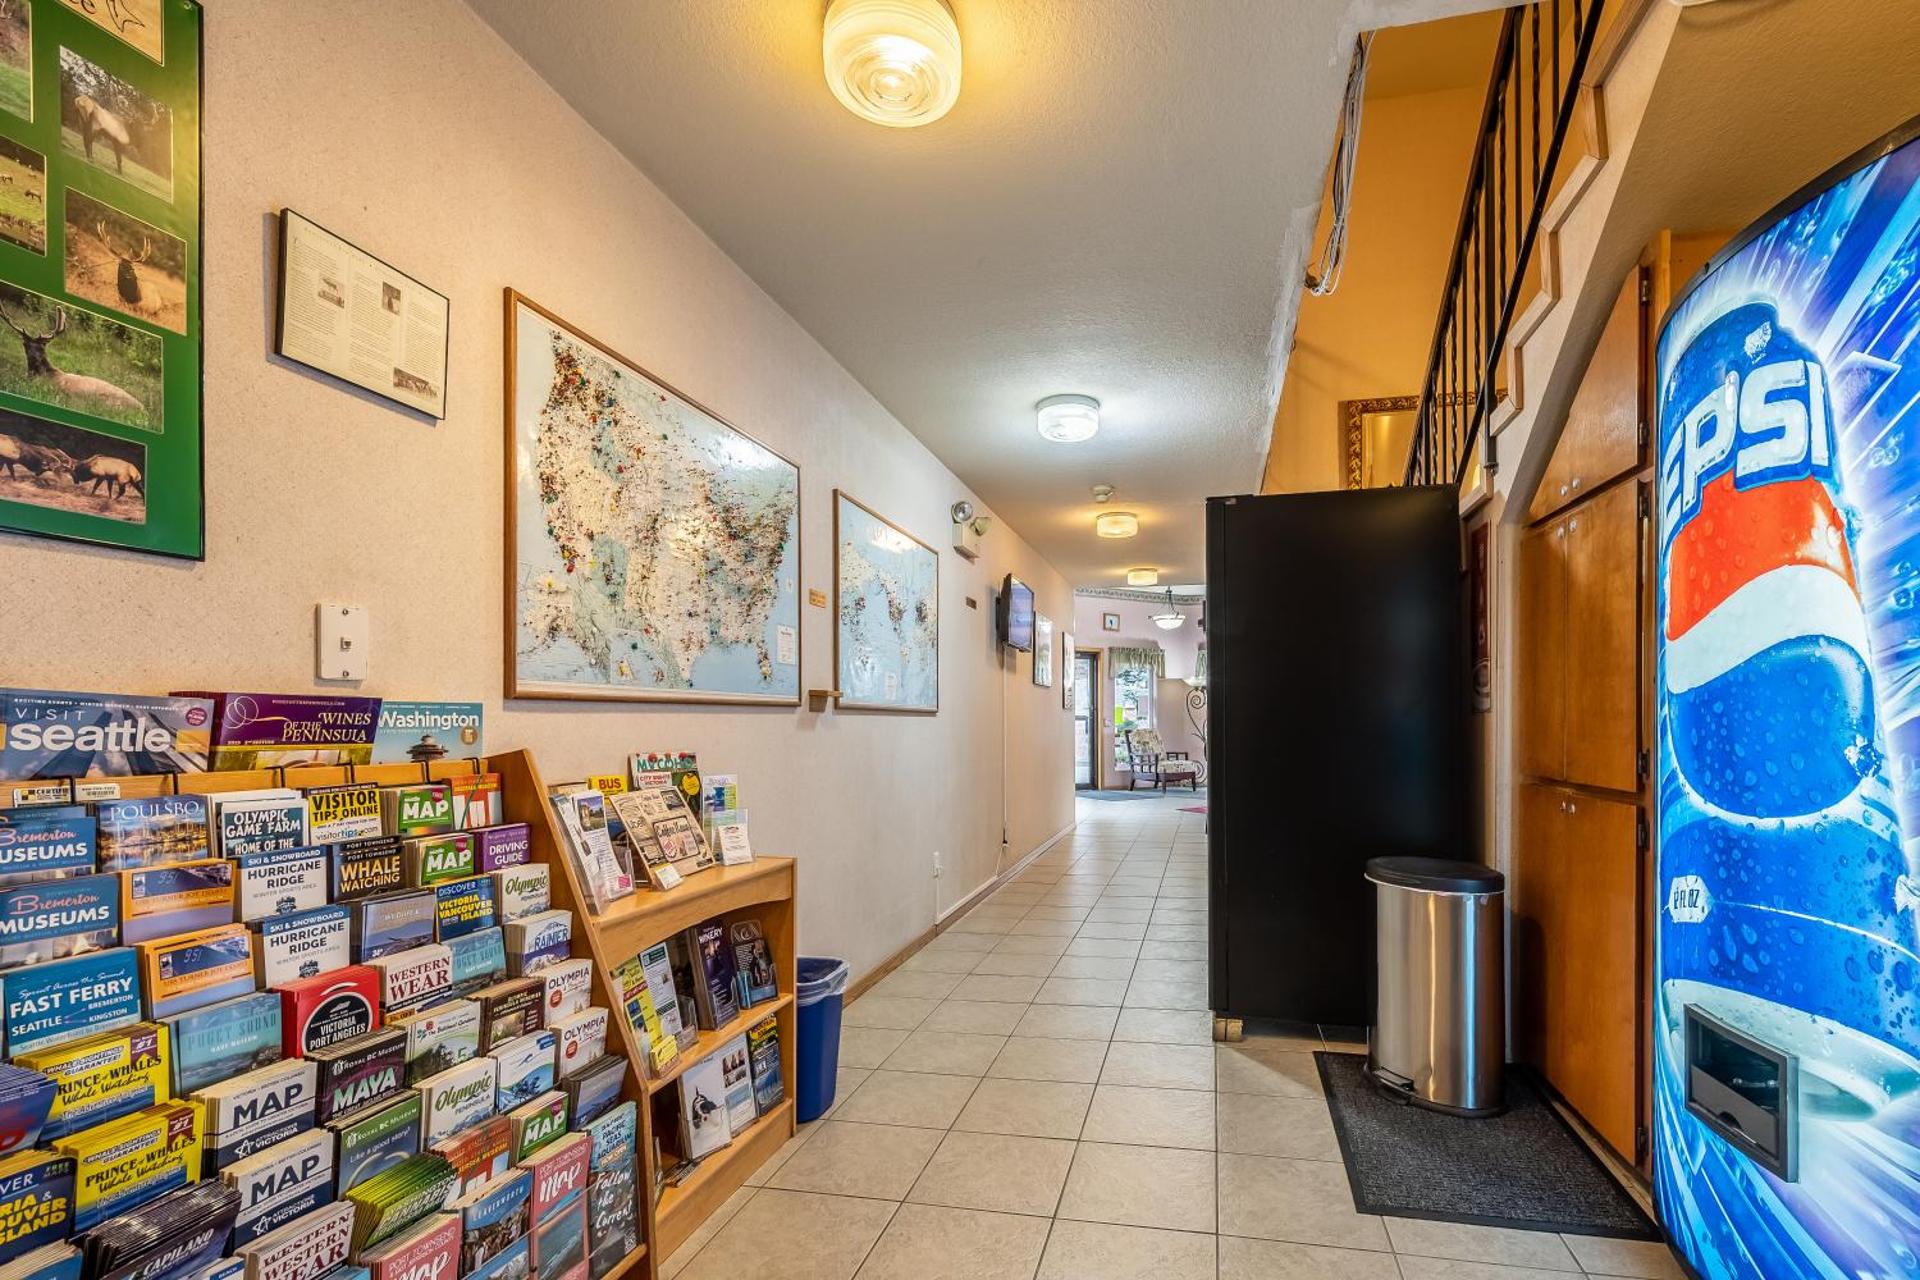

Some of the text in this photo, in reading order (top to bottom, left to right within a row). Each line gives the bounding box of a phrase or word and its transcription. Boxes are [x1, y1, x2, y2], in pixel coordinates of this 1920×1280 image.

[1663, 357, 1830, 547] EPSI
[15, 707, 86, 721] VISIT
[318, 712, 372, 726] WINES
[379, 711, 480, 731] Washington
[9, 716, 171, 753] seattle
[282, 728, 368, 743] PENINSULA
[284, 721, 322, 731] OF THE
[598, 777, 622, 790] BUS
[110, 800, 200, 821] POULSBO
[311, 790, 377, 811] VISITOR
[402, 799, 449, 820] MAP
[233, 809, 289, 825] OLYMPIC
[312, 805, 379, 823] TIPS ONLINE
[226, 819, 301, 838] GAME FARM
[0, 842, 88, 864] USEUMS
[234, 838, 295, 855] HOME OF THE
[247, 858, 262, 866] SKI
[271, 849, 321, 863] SNOWBOARD
[489, 840, 528, 856] DRIVING
[341, 856, 401, 881] WHALE
[427, 850, 472, 873] MAP
[494, 852, 523, 865] GUIDE
[247, 860, 321, 880] HURRICANE
[266, 874, 305, 889] RIDGE
[340, 872, 400, 893] WATCHING
[438, 881, 478, 897] DISCOVER
[505, 871, 548, 896] Olympic
[8, 894, 100, 915] Bremerton
[439, 894, 479, 911] VICTORIA
[439, 900, 493, 919] VANCOUVER
[0, 905, 110, 935] MUSEUMS
[270, 925, 284, 933] SKI
[292, 911, 344, 928] SNOWBOARD
[461, 907, 493, 922] ISLAND
[270, 922, 345, 948] HURRICANE
[534, 928, 569, 951] RAINIER
[698, 926, 723, 944] WINERY
[289, 938, 328, 955] RIDGE
[389, 956, 450, 984] WESTERN
[548, 967, 590, 990] OLYMPIA
[390, 969, 449, 1001] WEAR
[10, 976, 133, 1019] FAST FERRY
[88, 993, 134, 1010] BREMERTON
[88, 1007, 128, 1022] KINGSTON
[239, 1012, 277, 1036] SOUND
[320, 1015, 357, 1036] VICTORIA
[12, 1015, 62, 1037] SEATTLE
[309, 1023, 366, 1051] PORT ANGELES
[563, 1016, 605, 1041] OLYMPIA
[343, 1058, 366, 1070] ROYAL
[367, 1052, 377, 1061] BC
[57, 1073, 101, 1096] RINCE
[109, 1054, 162, 1079] WHALES
[62, 1086, 96, 1106] Whale
[100, 1071, 150, 1094] Watching
[332, 1066, 396, 1114] MAYA
[435, 1069, 493, 1112] Olympic
[233, 1082, 303, 1130] MAP
[379, 1120, 390, 1130] BC
[524, 1110, 566, 1146] MAP
[255, 1127, 298, 1149] VICTORIA
[85, 1157, 138, 1188] PRINCE
[145, 1136, 197, 1162] WHALES
[99, 1171, 133, 1194] Whale
[136, 1151, 184, 1178] Watching
[250, 1154, 320, 1208] MAP
[595, 1167, 632, 1193] Follow
[272, 1198, 316, 1223] VICTORIA
[473, 1185, 524, 1222] LEAVENWORTH
[264, 1212, 350, 1267] WESTERN
[143, 1228, 215, 1276] CAPILANO
[265, 1224, 350, 1280] WESTERN
